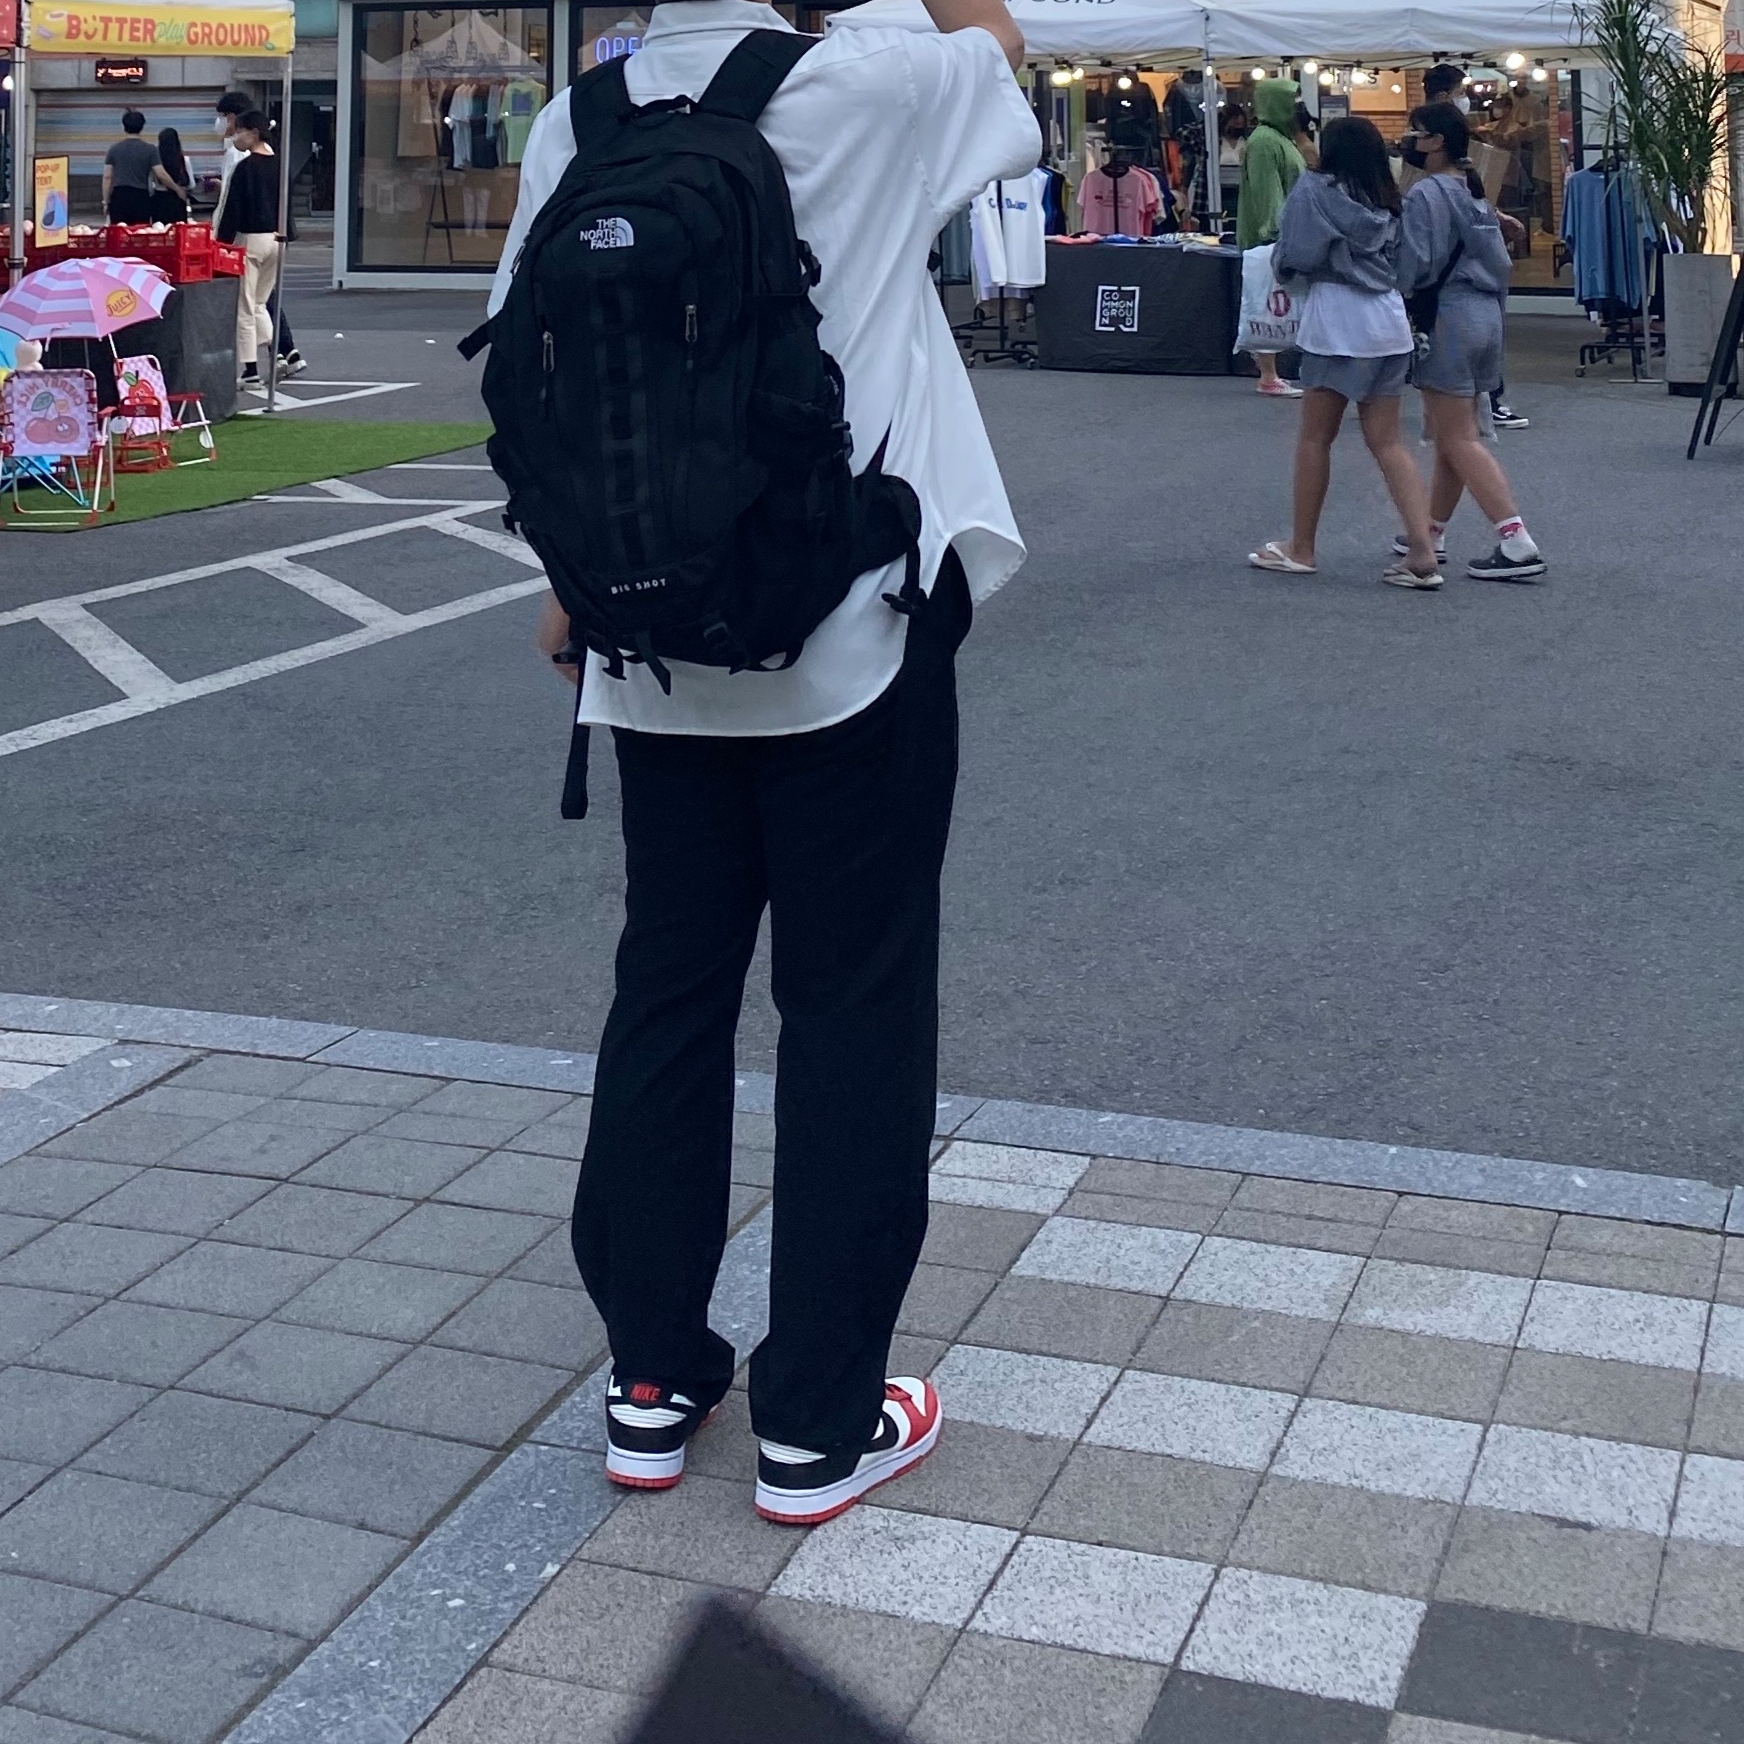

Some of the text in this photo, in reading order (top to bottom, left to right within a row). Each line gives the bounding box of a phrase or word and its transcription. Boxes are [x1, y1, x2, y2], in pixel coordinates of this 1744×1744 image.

[65, 14, 270, 47] BUTTER play GROUND
[595, 36, 641, 64] OPE
[595, 217, 617, 229] THE
[579, 228, 617, 242] NORTH
[590, 237, 617, 250] FACE
[1103, 291, 1120, 301] CO
[1101, 300, 1134, 309] MMON
[1101, 308, 1134, 317] GROU
[610, 577, 666, 595] BIG SHOT
[630, 1383, 661, 1401] NIKE
